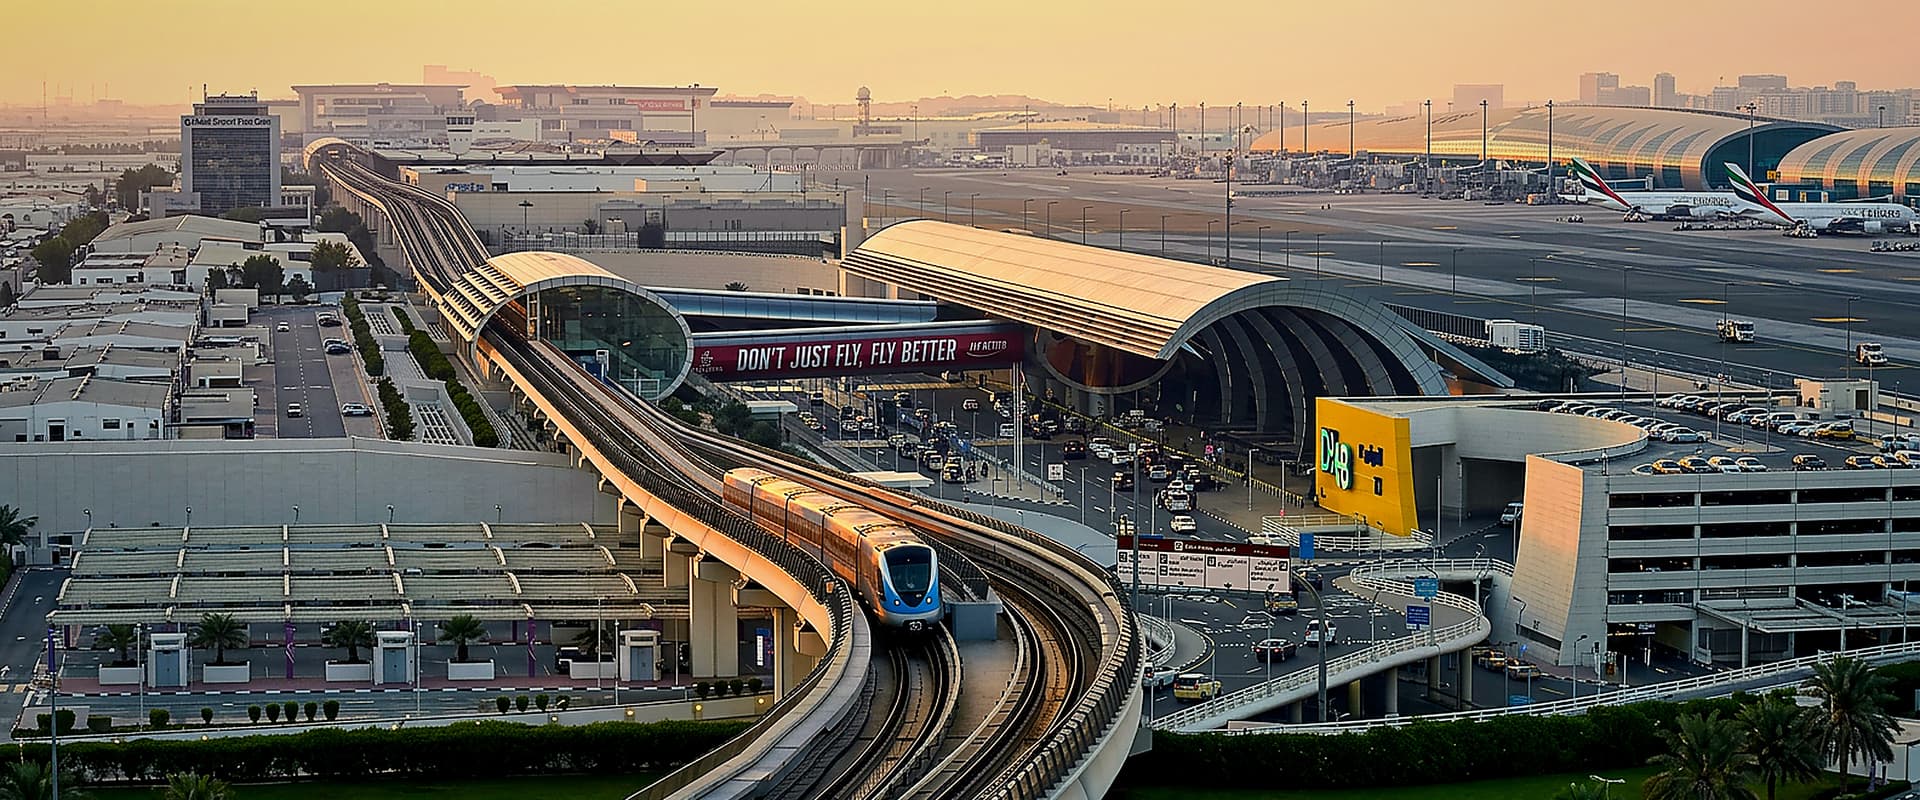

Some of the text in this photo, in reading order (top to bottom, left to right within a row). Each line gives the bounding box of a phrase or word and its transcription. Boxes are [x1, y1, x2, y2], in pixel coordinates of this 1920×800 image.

[736, 338, 957, 371] DON'T JUST FLY, FLY BETTER
